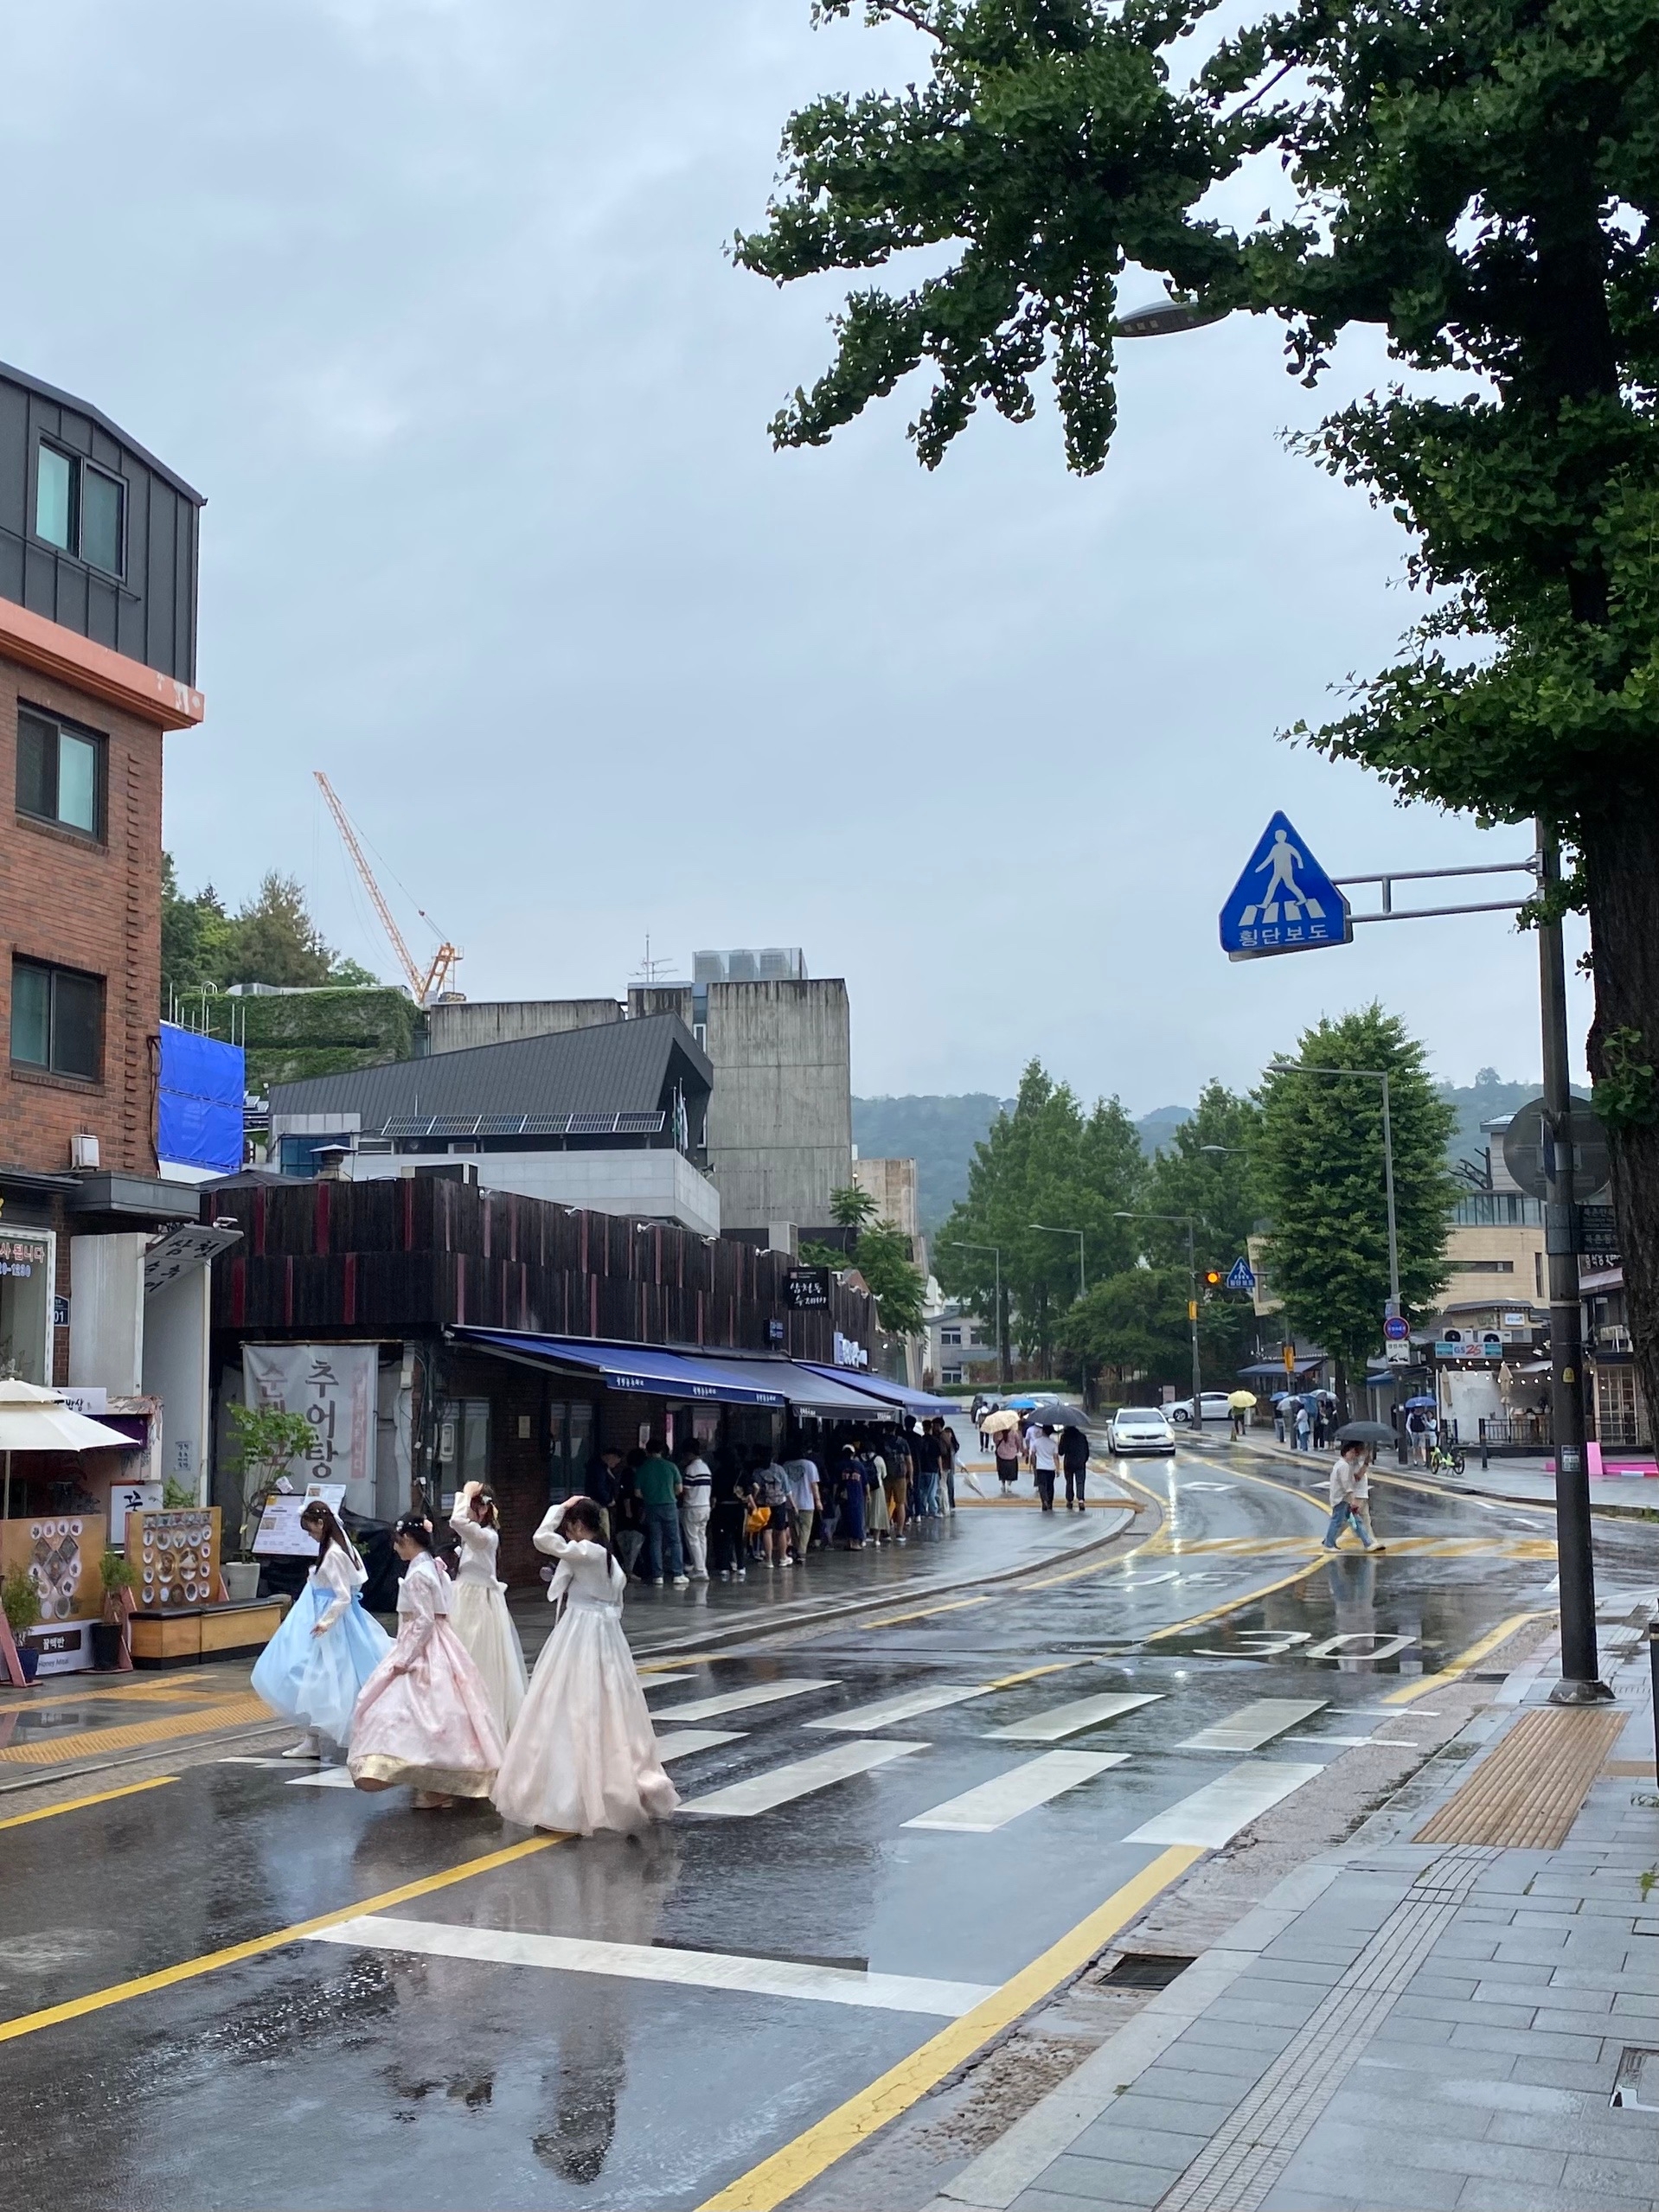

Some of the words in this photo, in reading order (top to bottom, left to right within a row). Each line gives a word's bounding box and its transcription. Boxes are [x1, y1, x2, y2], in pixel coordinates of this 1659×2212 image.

[1239, 924, 1329, 947] 횡단보도
[13, 1243, 45, 1263] 됩니다
[1454, 1343, 1483, 1357] GS25
[305, 1359, 339, 1479] 추어탕
[1193, 1630, 1417, 1660] 30
